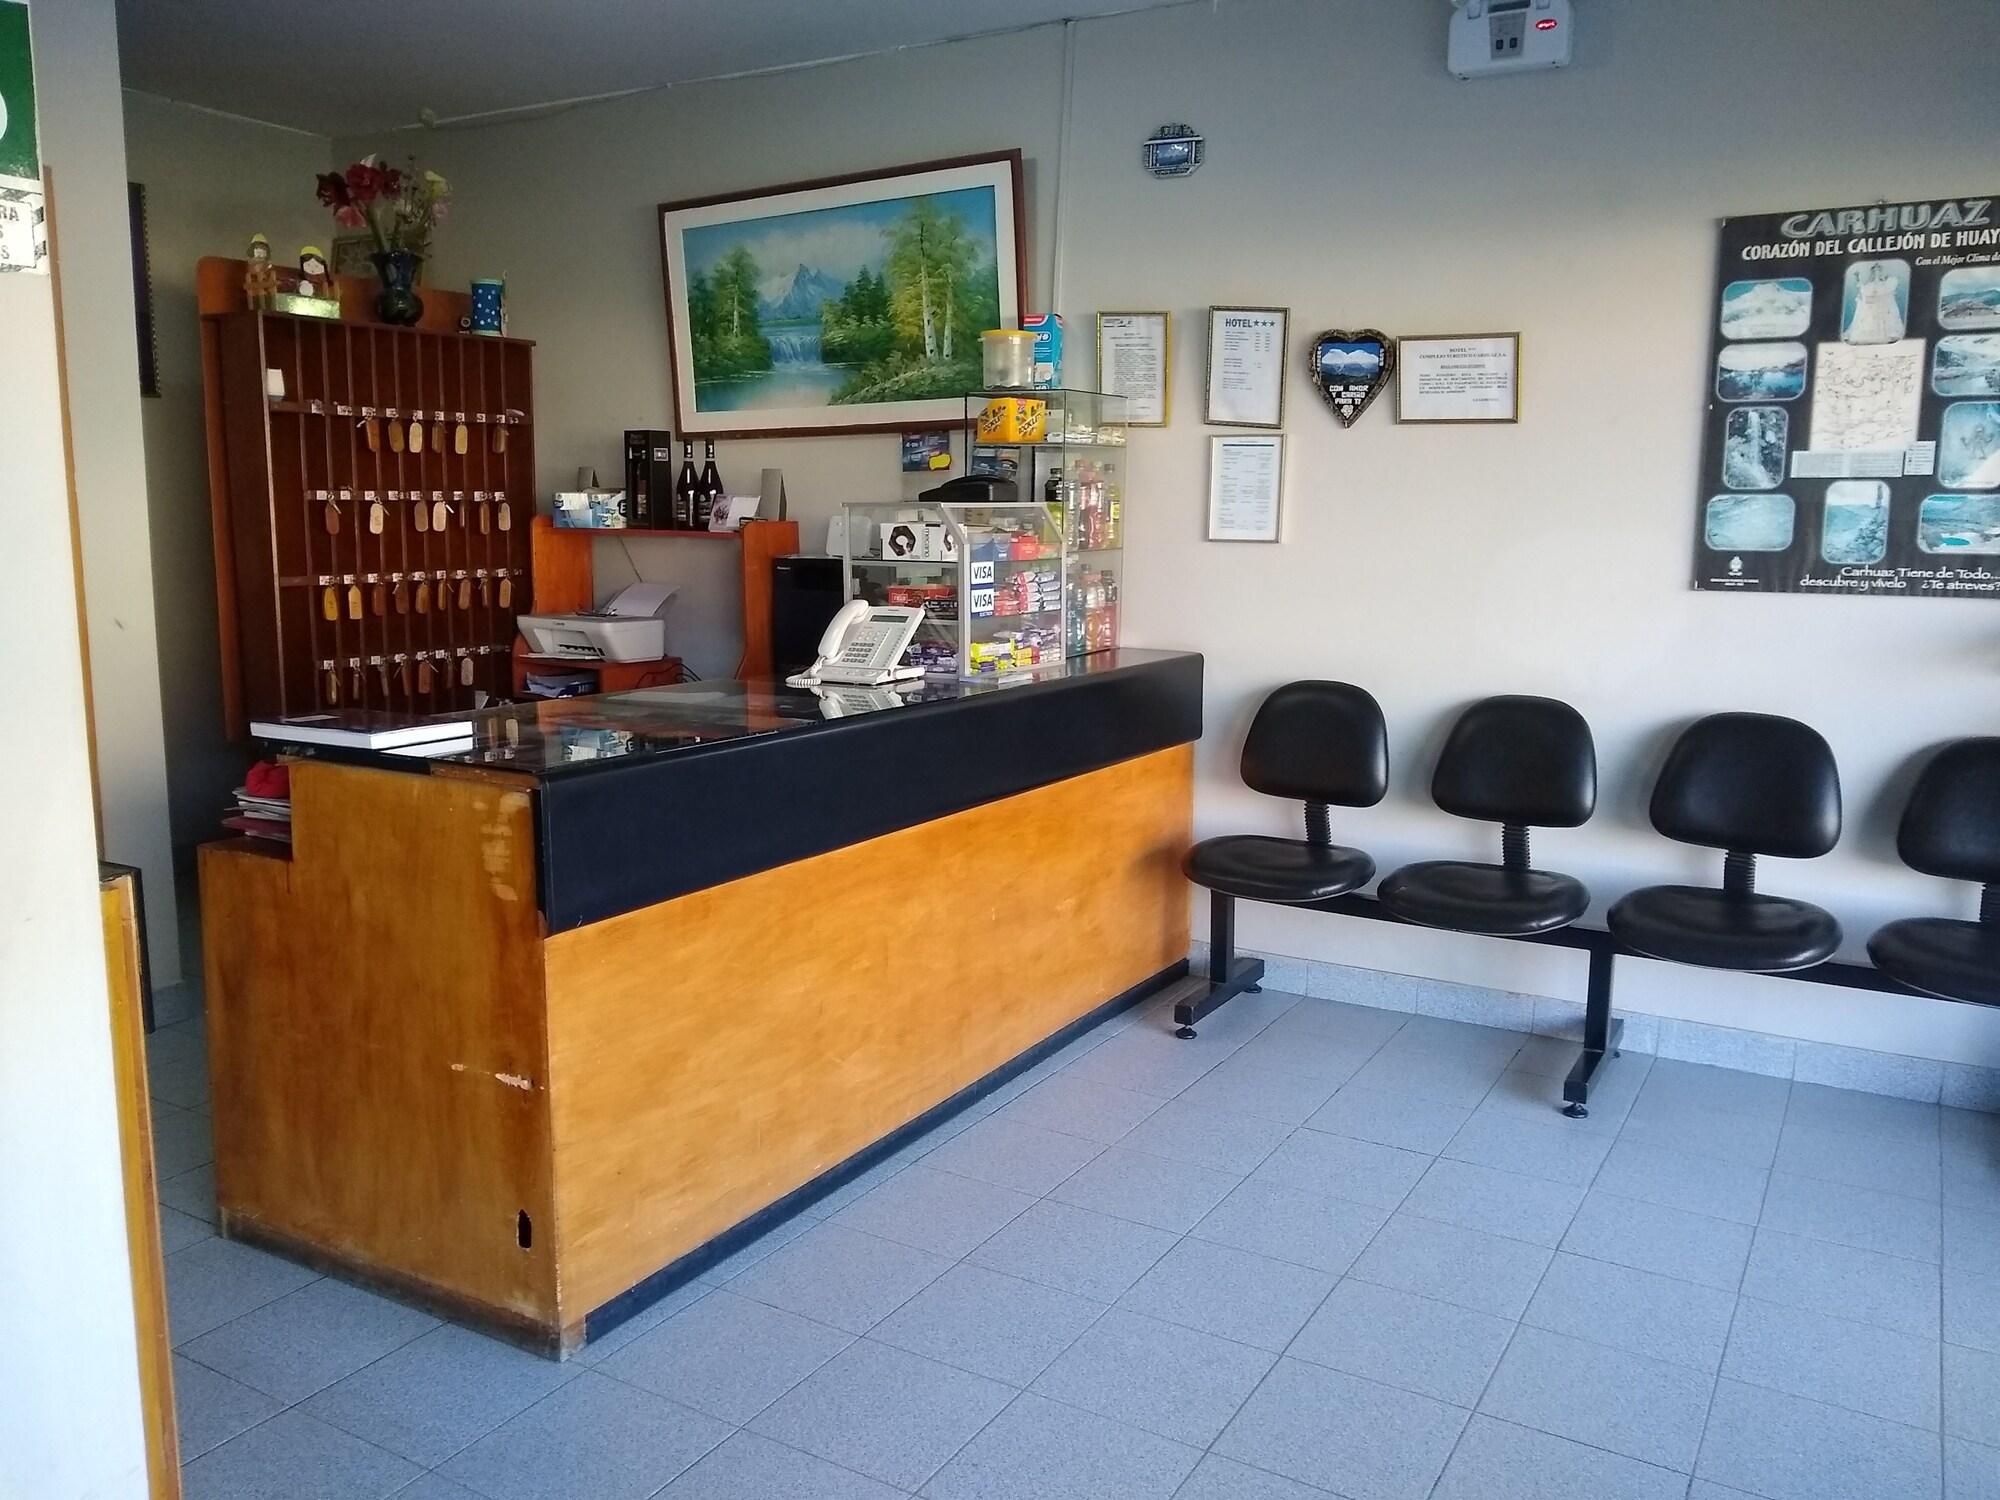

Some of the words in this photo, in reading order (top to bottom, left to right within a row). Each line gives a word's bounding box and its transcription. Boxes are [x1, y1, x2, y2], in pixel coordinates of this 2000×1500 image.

[1781, 201, 1991, 238] CARHUAZ
[1742, 240, 1810, 260] CORAZÓN
[1815, 240, 1843, 256] DEL
[1847, 232, 1925, 254] CALLEJÓN
[1931, 232, 1951, 248] DE
[1956, 228, 2000, 247] HUAY
[1915, 256, 1932, 266] Con
[1941, 254, 1965, 266] Mejor
[1225, 318, 1252, 328] HOTEL
[974, 566, 992, 579] VISA
[1841, 565, 1895, 577] Carhuaz
[1896, 567, 1934, 578] Tiene
[1936, 566, 1954, 578] de
[1800, 574, 1858, 587] descubre
[1859, 578, 1869, 591] y
[1921, 579, 1944, 590] ¿Te
[1946, 579, 2000, 591] atreves?
[974, 594, 992, 608] VISA
